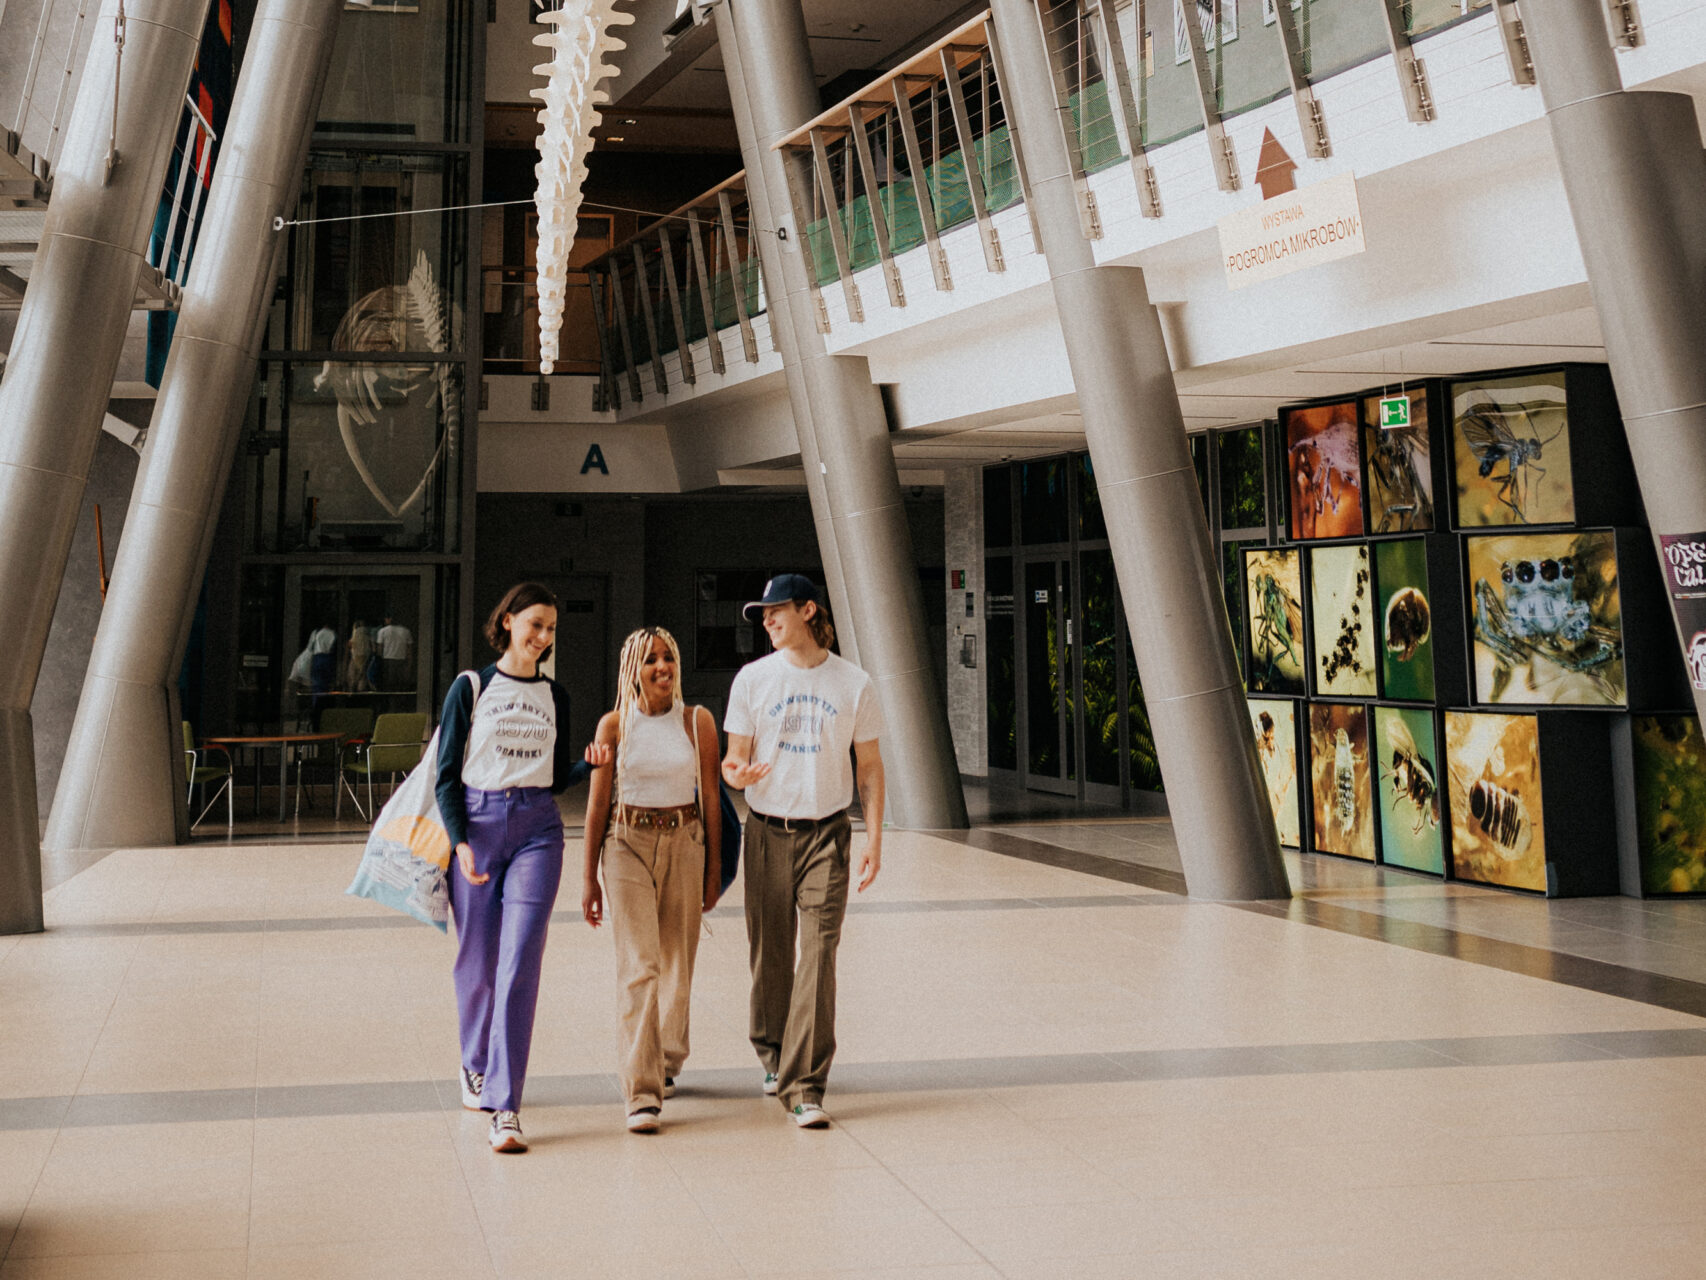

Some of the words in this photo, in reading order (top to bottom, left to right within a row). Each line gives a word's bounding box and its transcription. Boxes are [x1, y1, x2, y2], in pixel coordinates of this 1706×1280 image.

[1261, 205, 1305, 231] WYSTAWA
[1228, 238, 1290, 272] POGROMCA
[1290, 216, 1357, 254] MIKROBÓW
[580, 443, 609, 475] A
[496, 719, 548, 741] 1970
